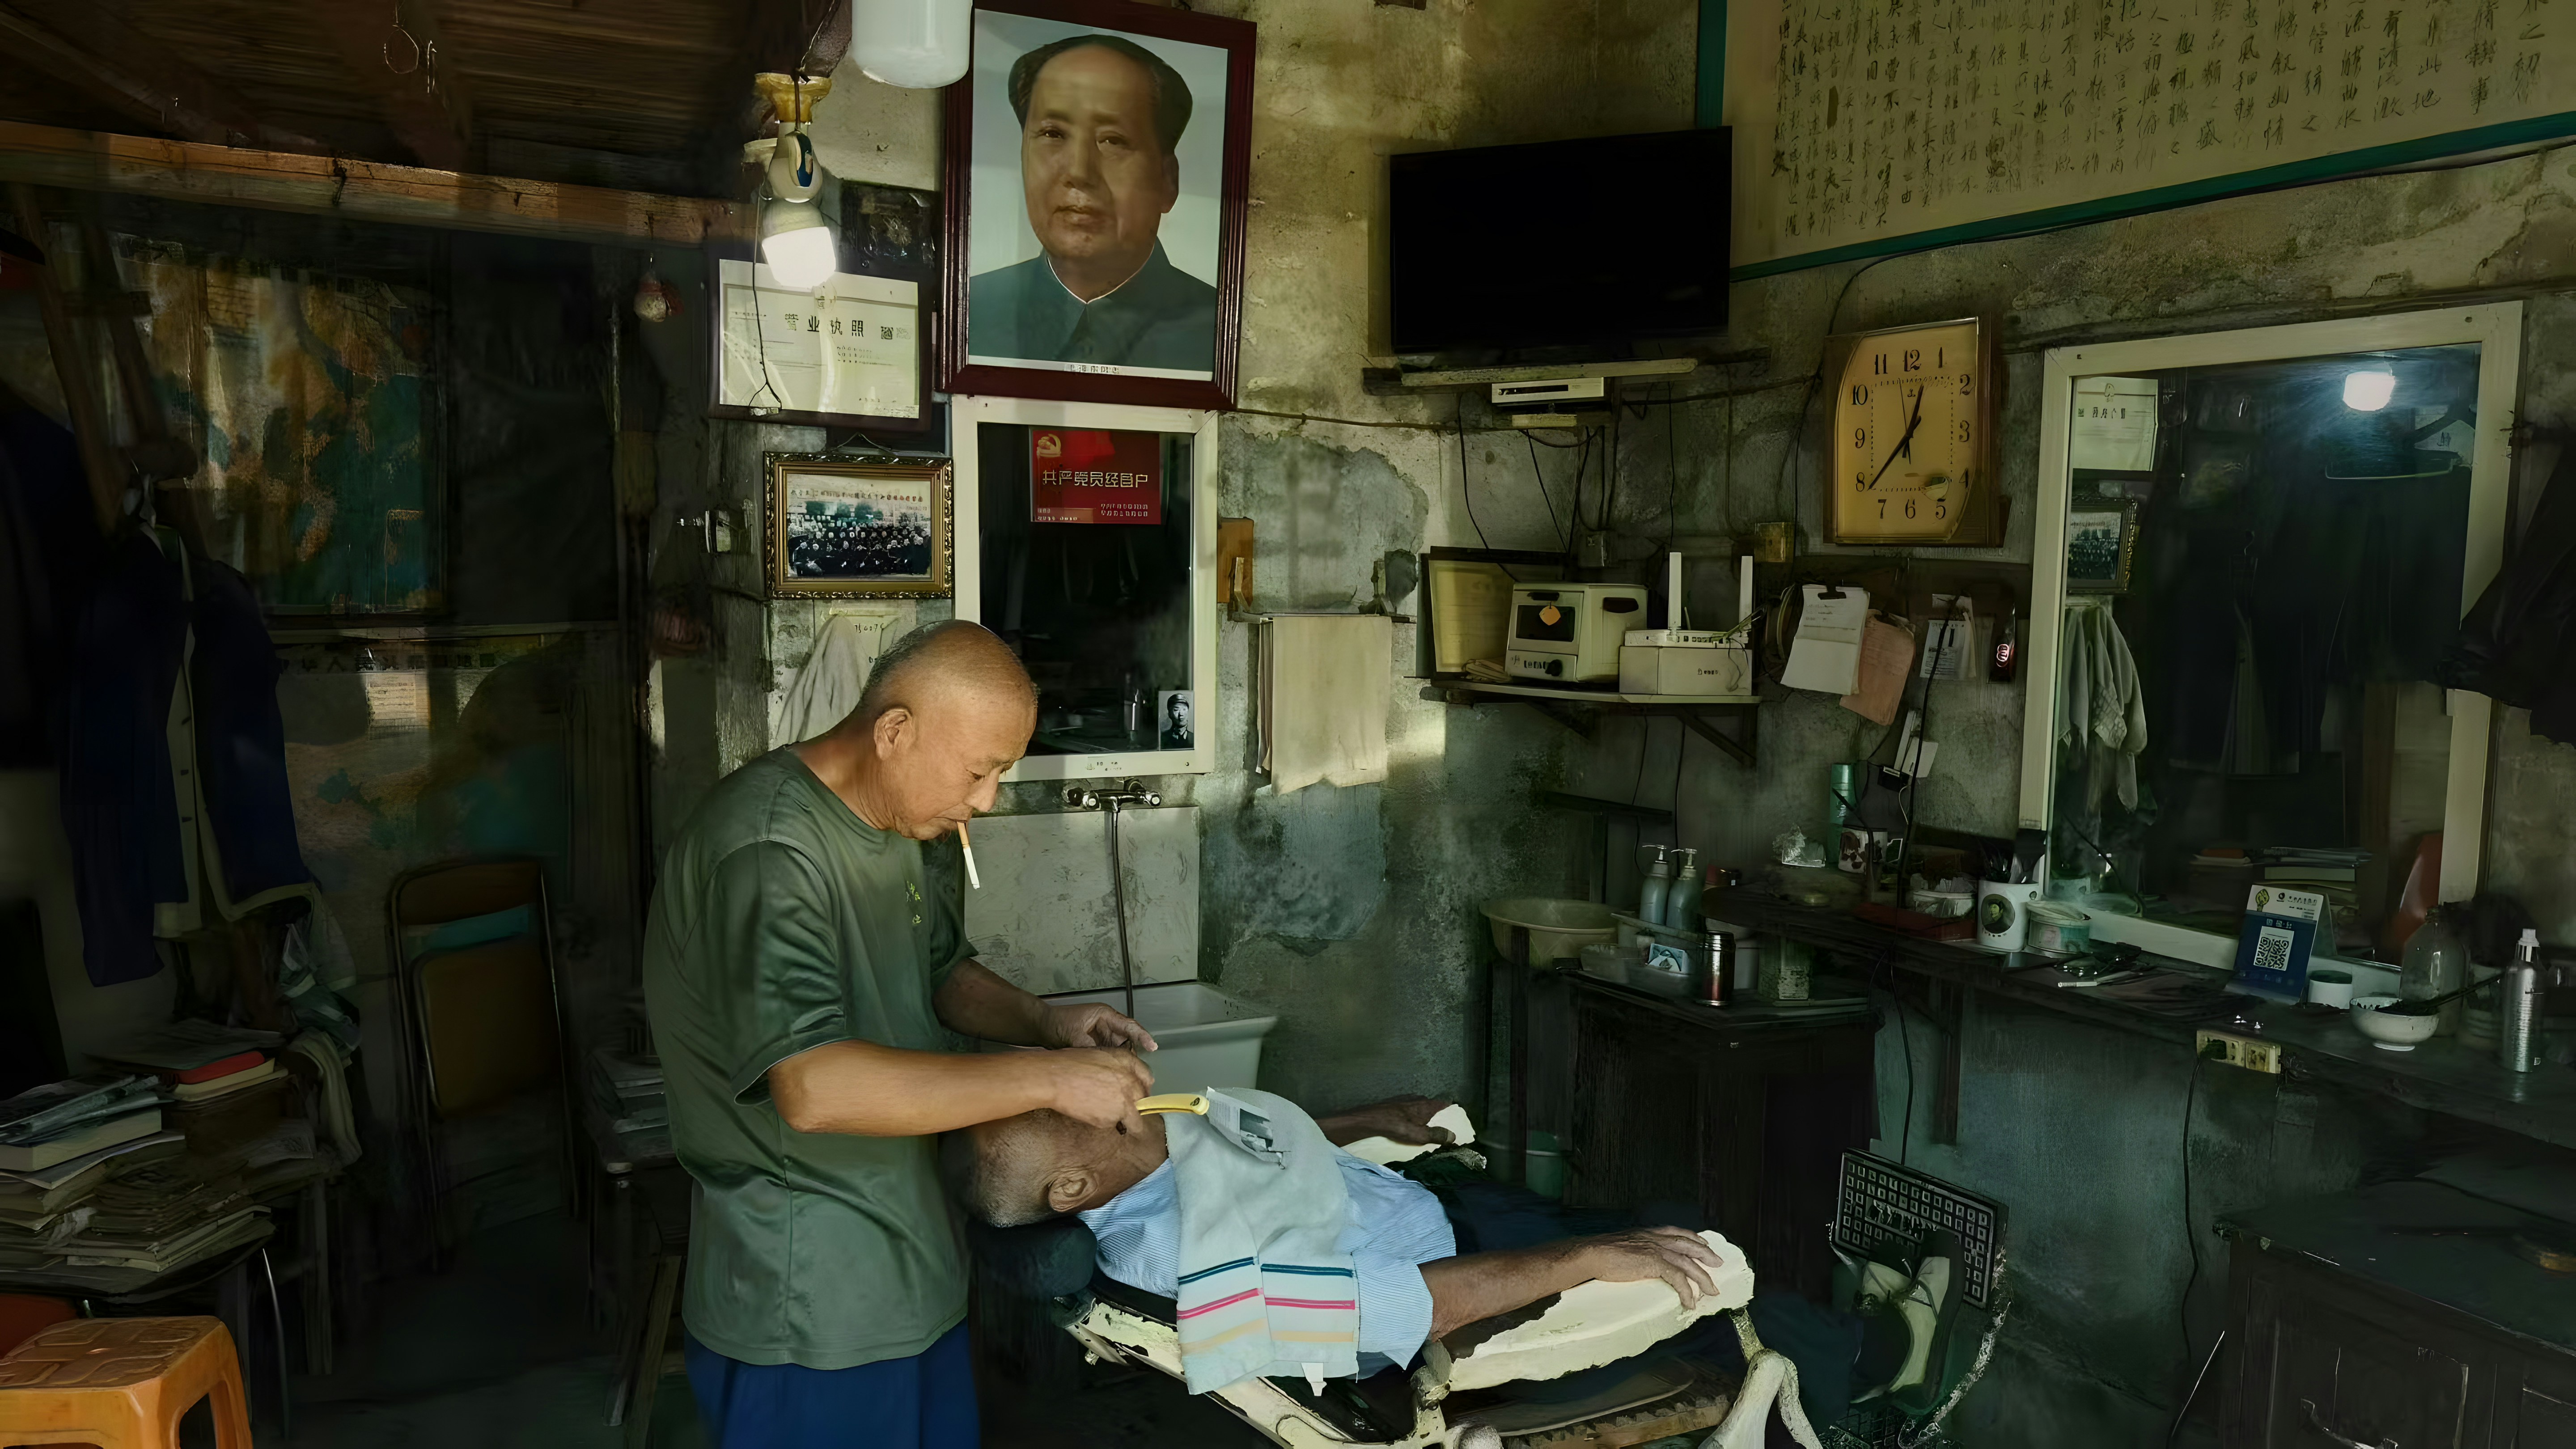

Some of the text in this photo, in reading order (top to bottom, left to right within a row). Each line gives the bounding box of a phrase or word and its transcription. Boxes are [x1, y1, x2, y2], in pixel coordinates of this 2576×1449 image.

[1874, 353, 1888, 375] 11
[1904, 349, 1922, 372] 12
[1938, 347, 1943, 369] 1
[1852, 384, 1868, 406] 10
[1959, 374, 1973, 396] 2
[1855, 428, 1865, 449] 9
[1959, 420, 1970, 442] 3
[1855, 472, 1865, 492] 8
[1959, 467, 1969, 489] 4
[1877, 499, 1887, 519] 7
[1905, 499, 1916, 519] 6
[1935, 498, 1946, 520] 5
